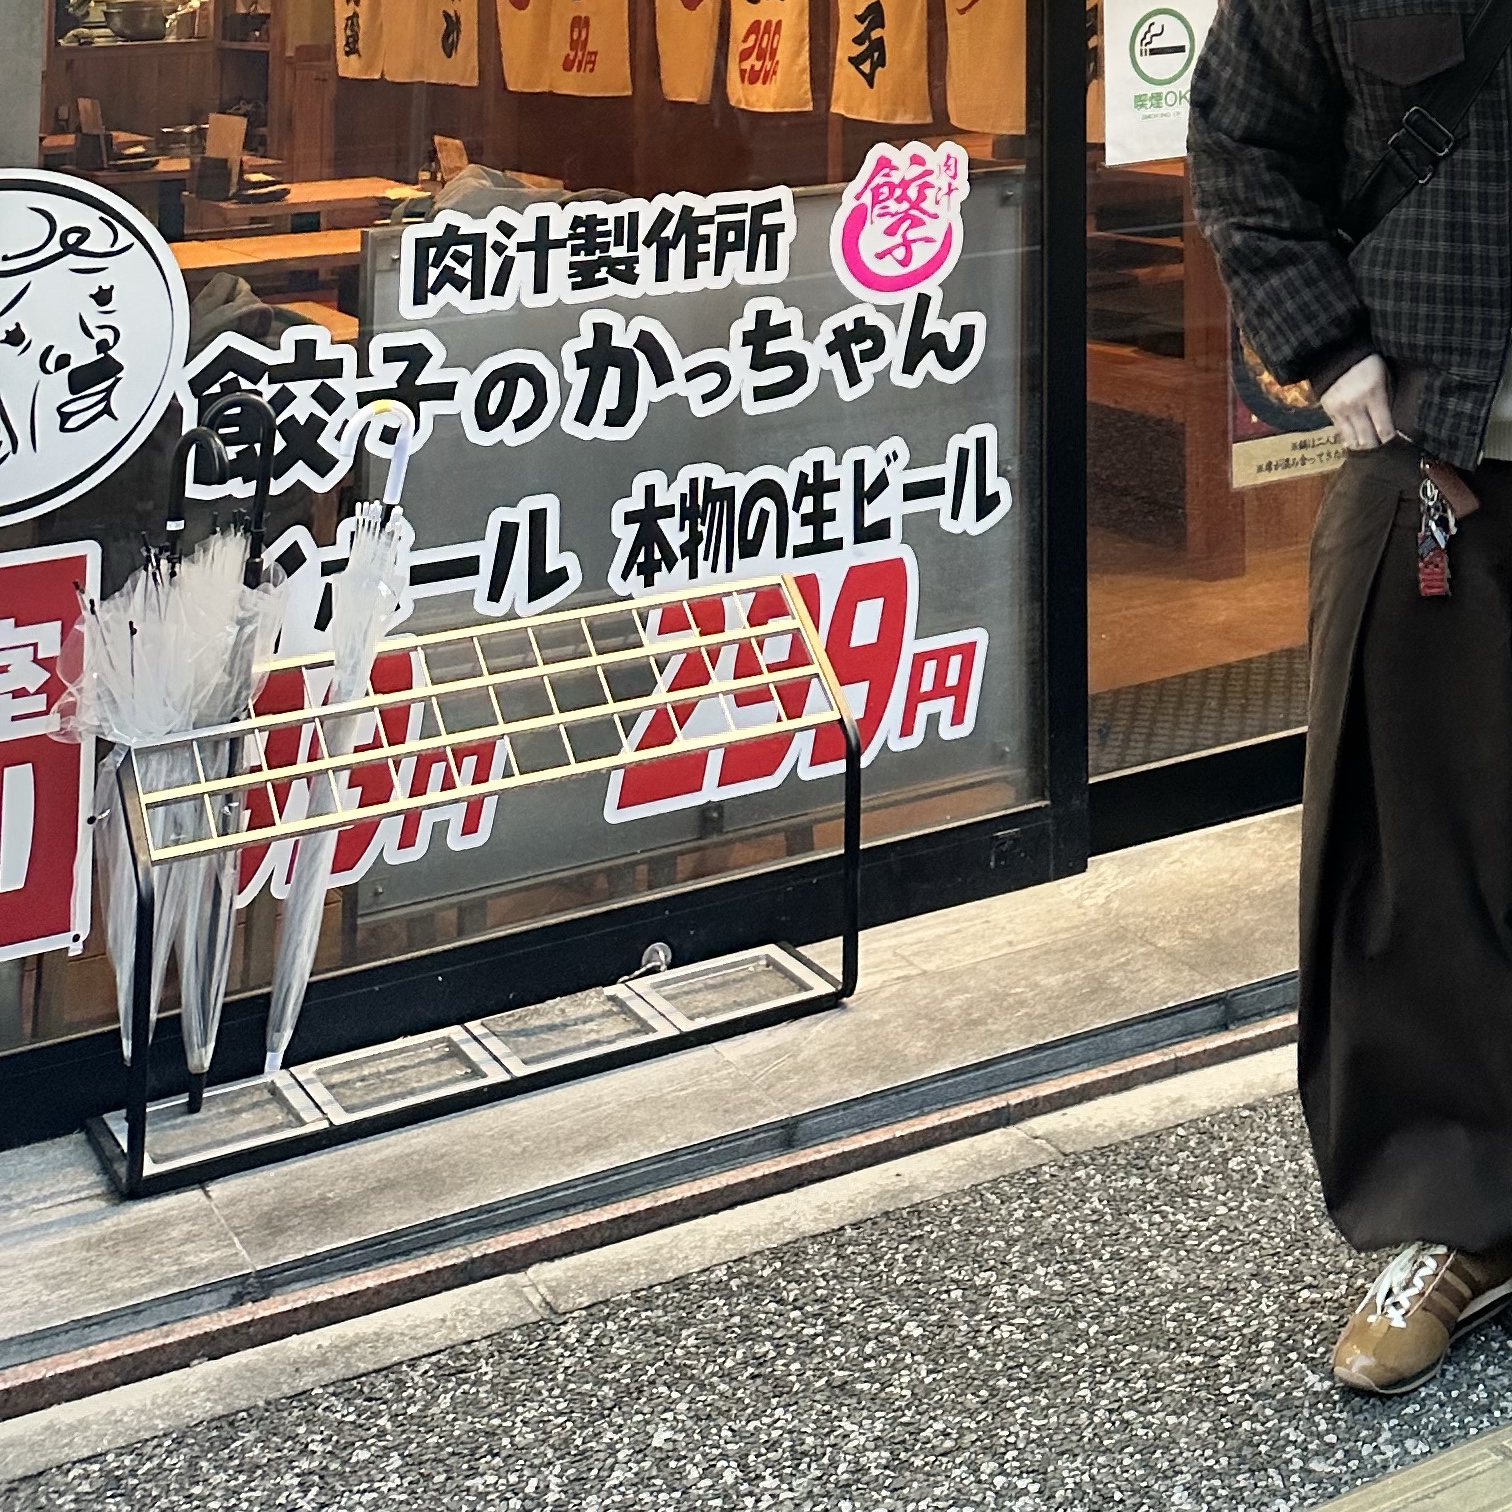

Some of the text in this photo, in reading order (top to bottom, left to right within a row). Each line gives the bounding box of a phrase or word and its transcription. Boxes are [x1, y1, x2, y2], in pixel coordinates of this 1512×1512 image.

[413, 198, 786, 306] 肉汁製作所
[620, 436, 1001, 589] 本物の生ビール
